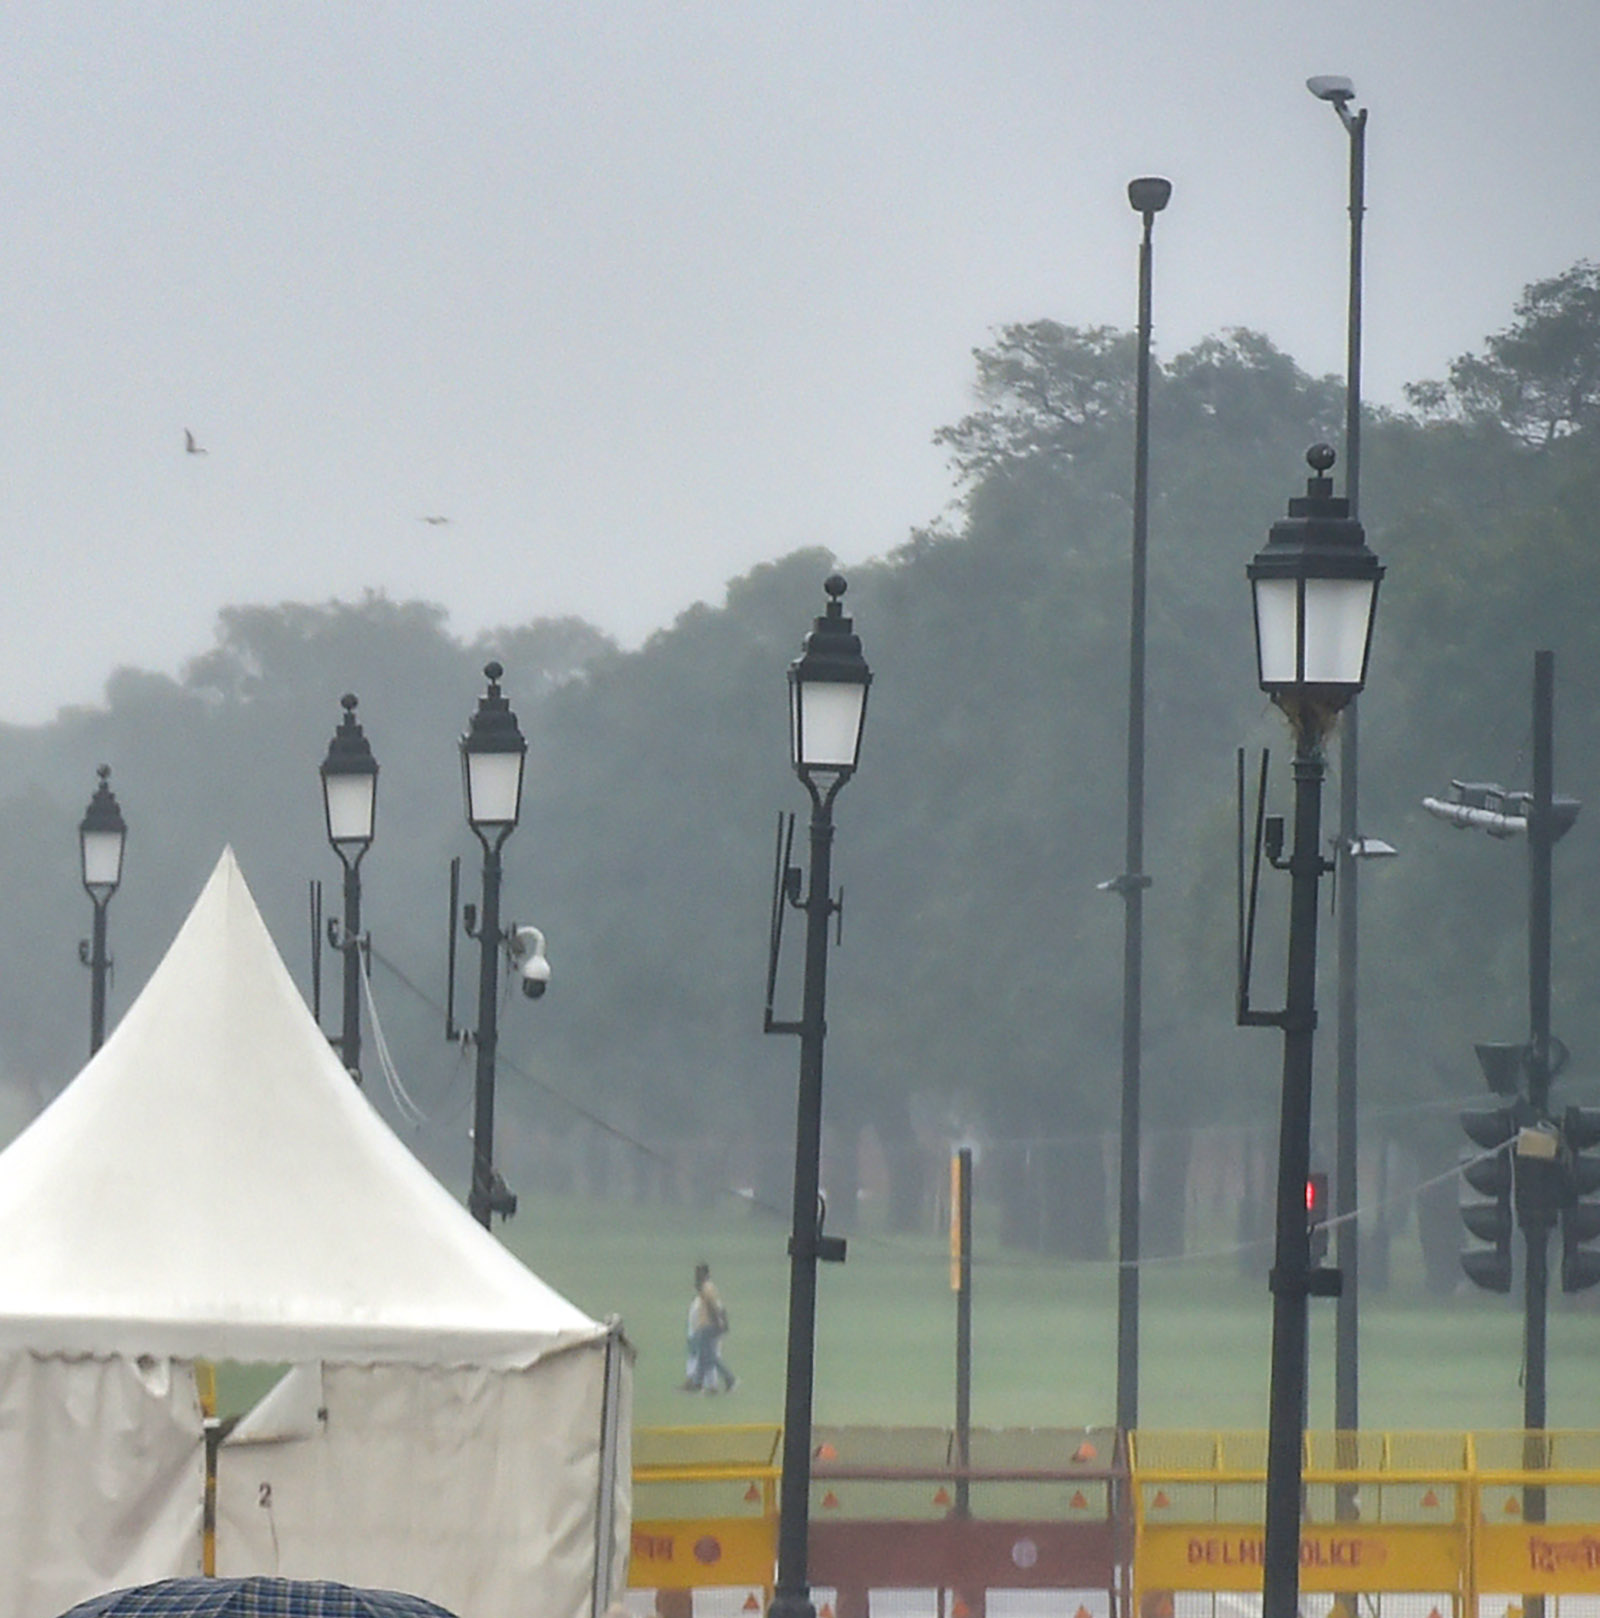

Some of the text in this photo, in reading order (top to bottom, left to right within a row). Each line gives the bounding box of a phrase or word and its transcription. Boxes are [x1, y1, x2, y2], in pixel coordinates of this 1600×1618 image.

[259, 1482, 272, 1508] 2
[1188, 1538, 1364, 1568] DELHI OLICE
